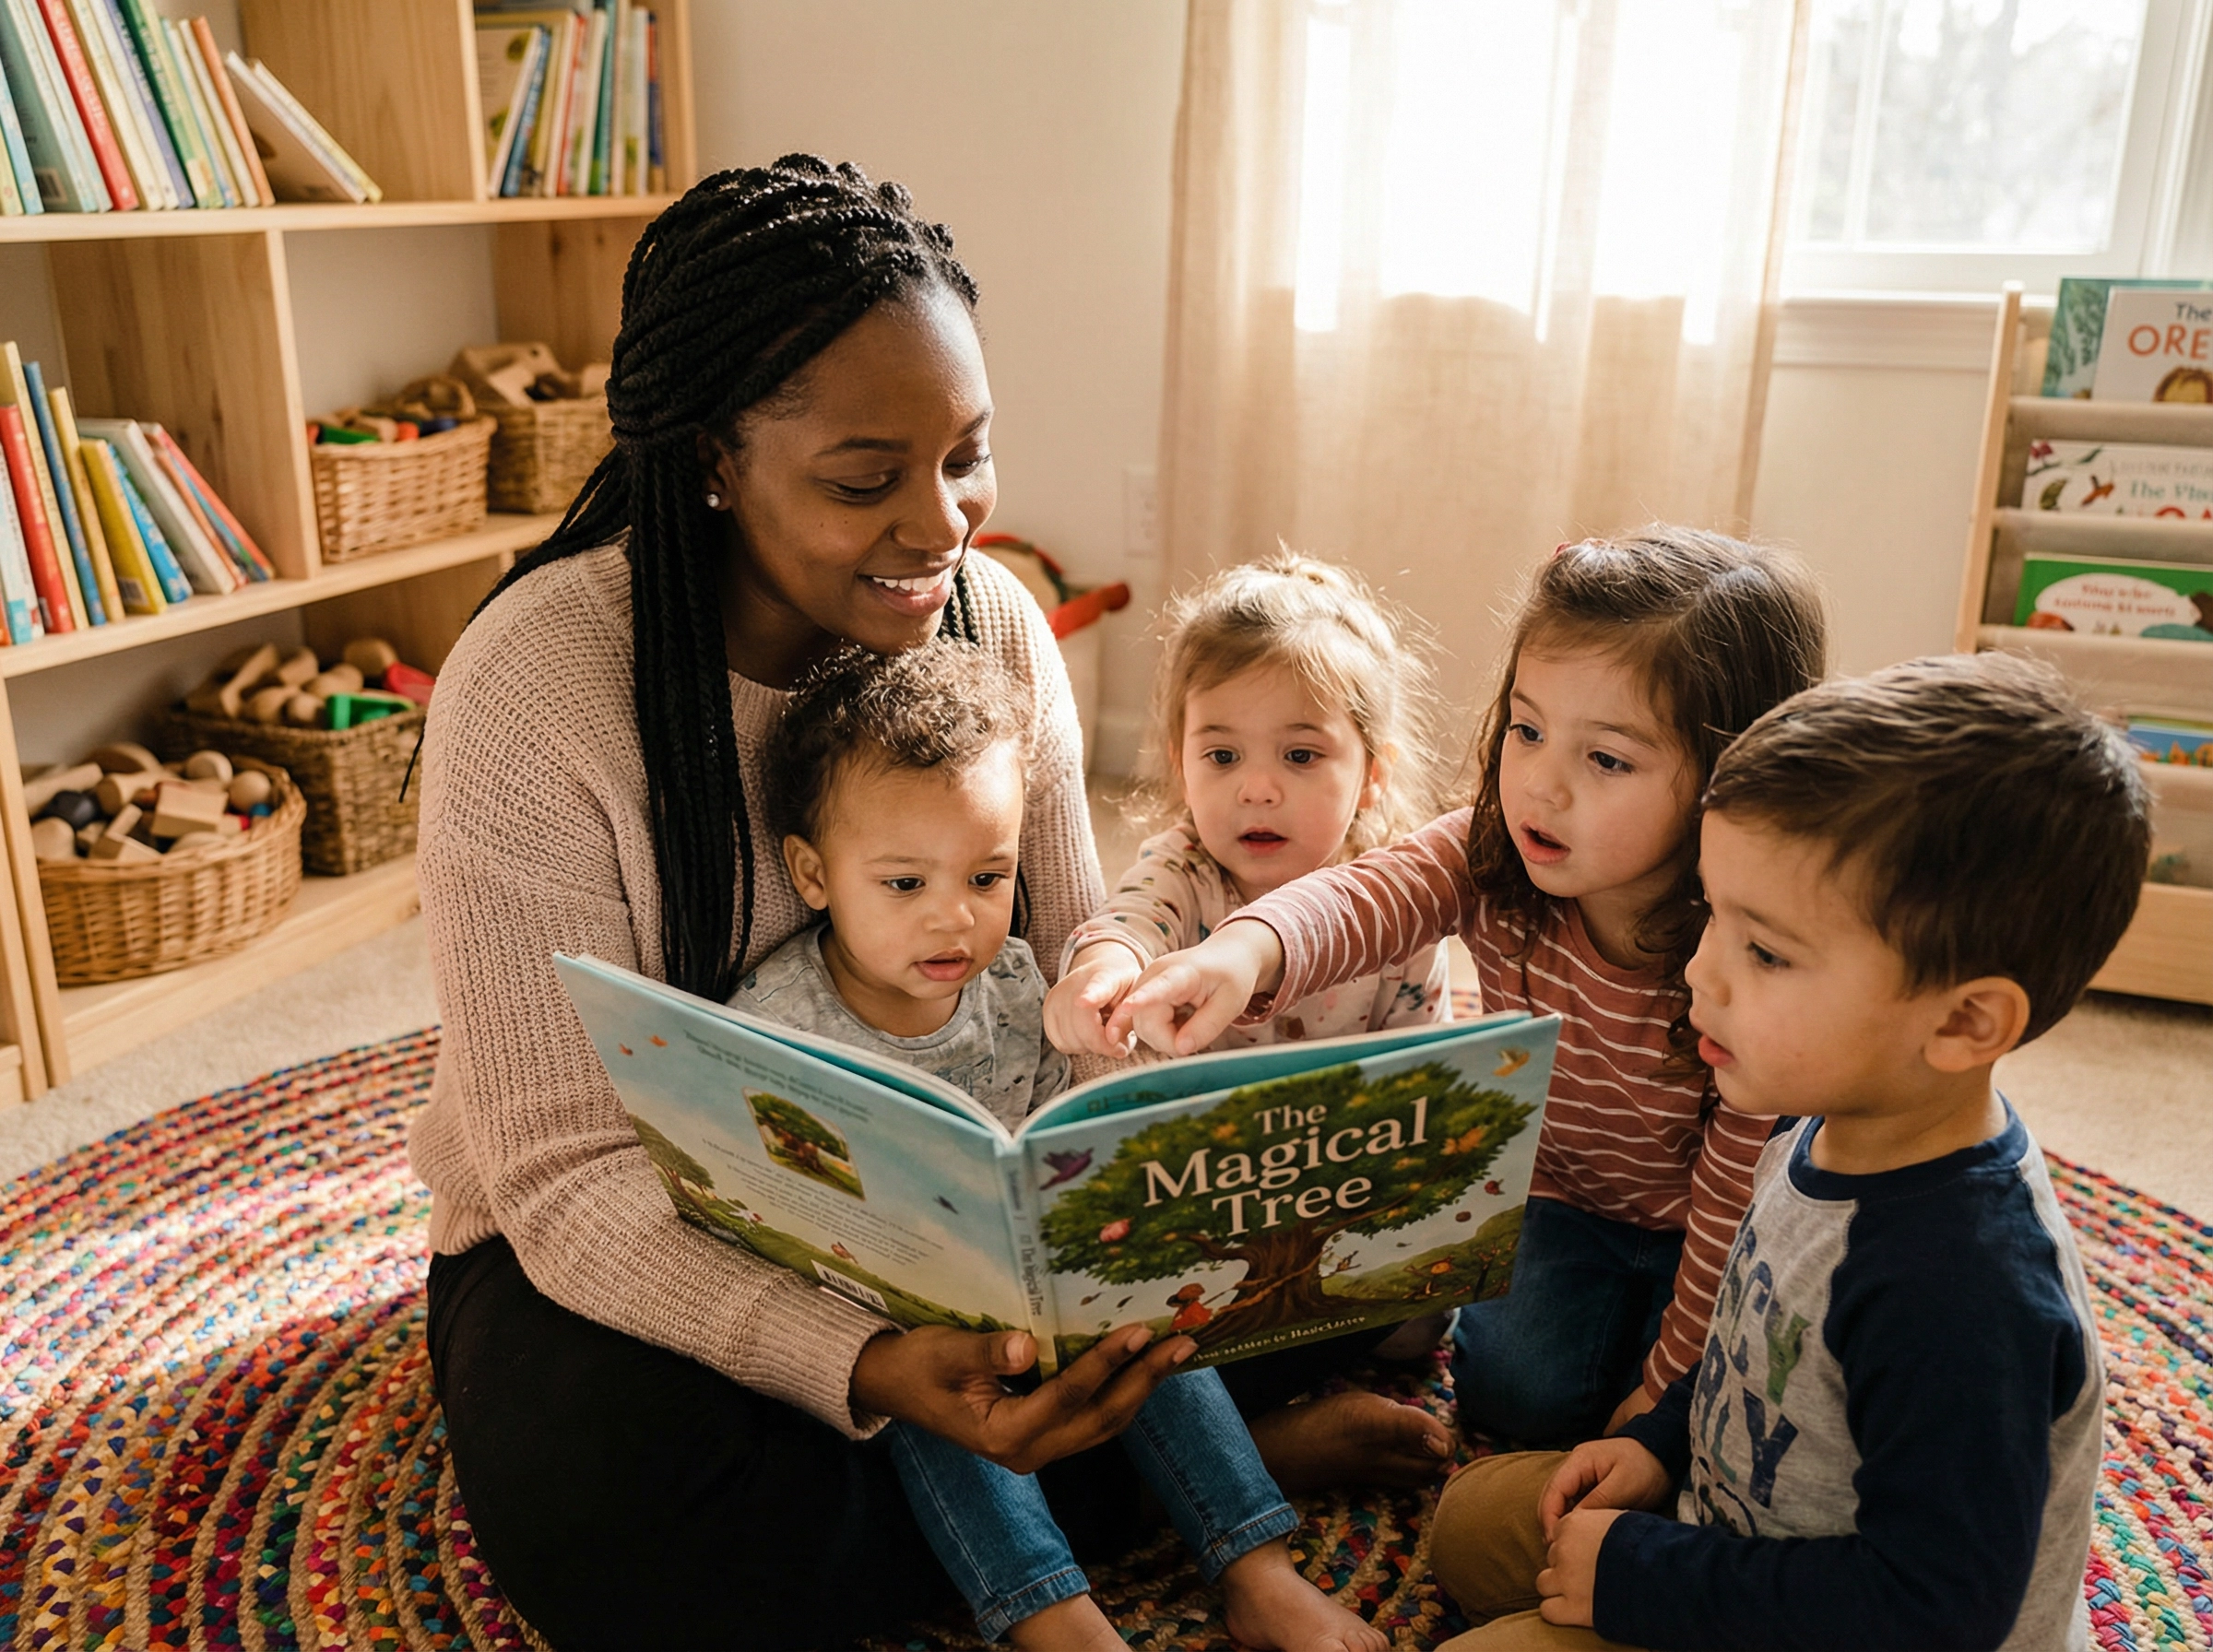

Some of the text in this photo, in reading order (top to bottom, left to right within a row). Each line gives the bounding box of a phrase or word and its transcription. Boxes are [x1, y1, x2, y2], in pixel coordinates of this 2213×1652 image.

[2175, 301, 2212, 323] The
[1254, 1104, 1327, 1135] The
[1140, 1095, 1429, 1208] Magical
[1212, 1177, 1372, 1236] Tree
